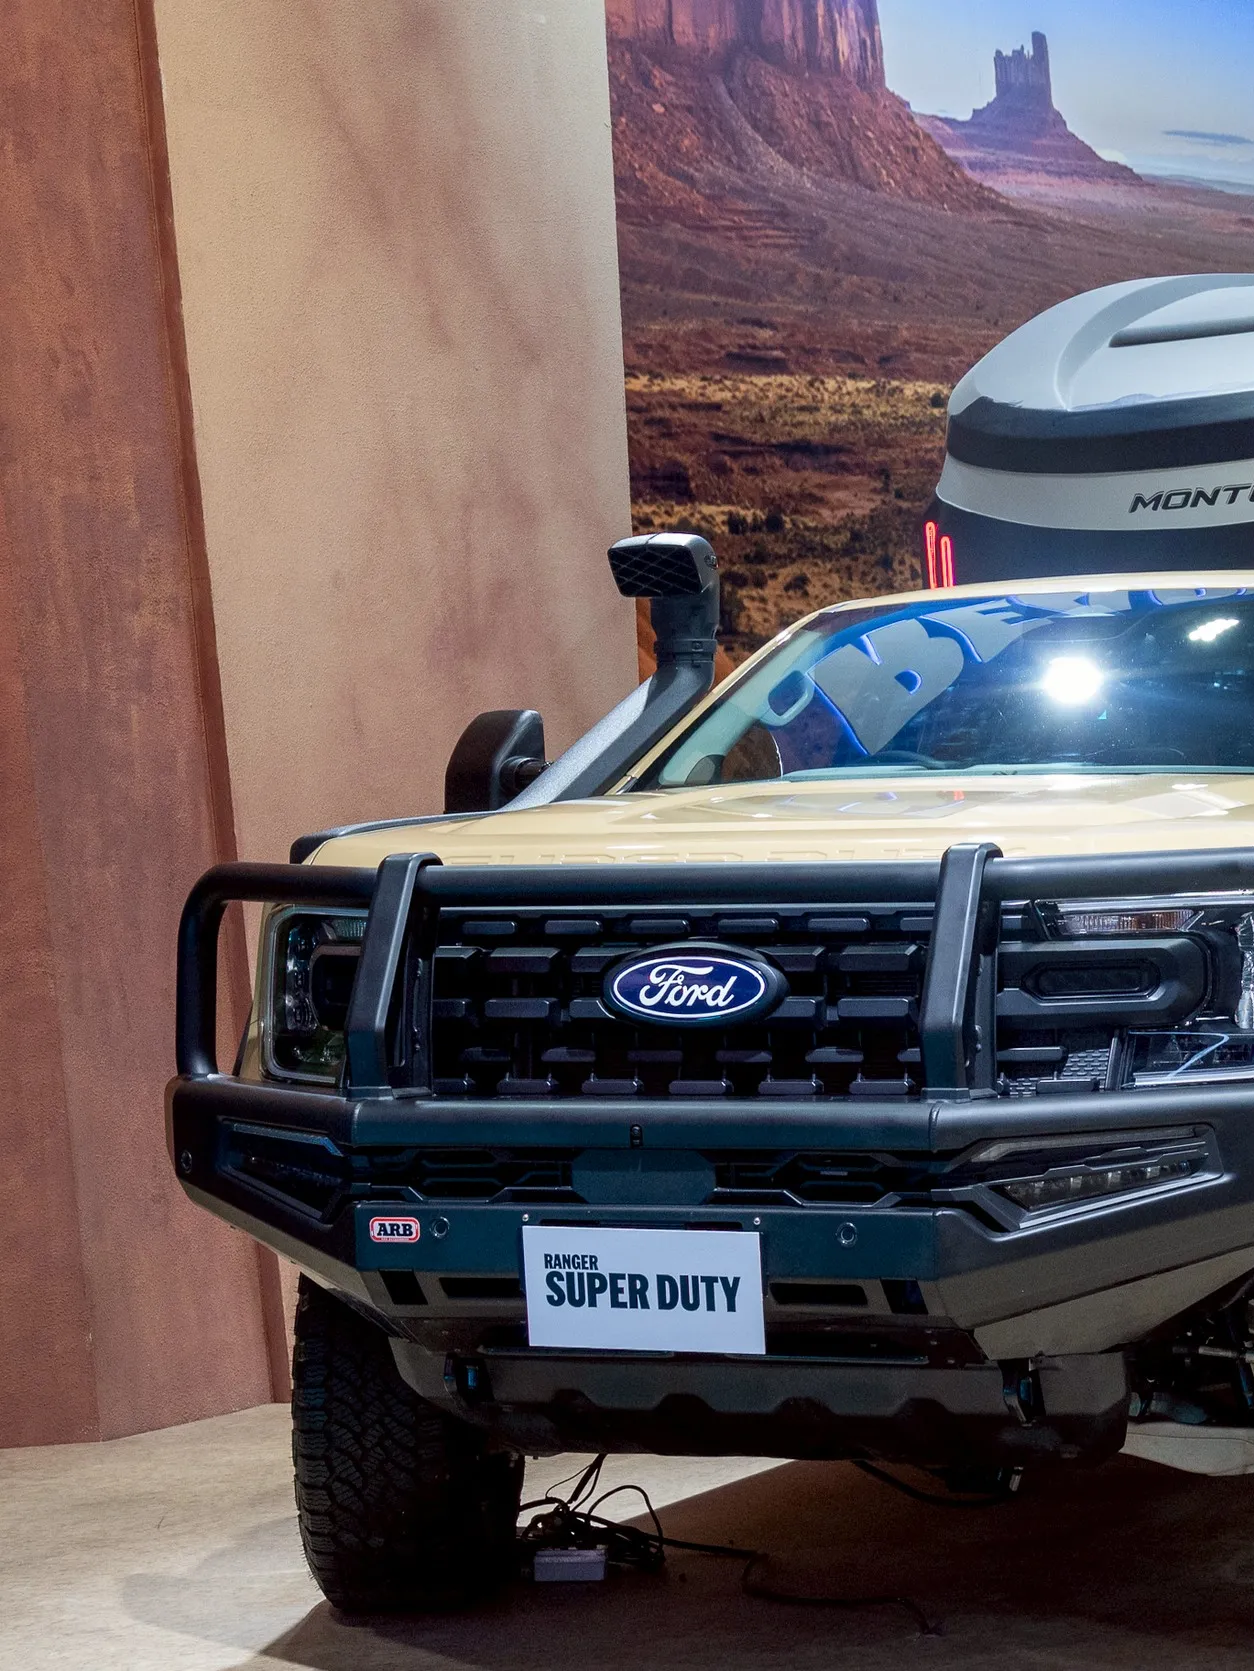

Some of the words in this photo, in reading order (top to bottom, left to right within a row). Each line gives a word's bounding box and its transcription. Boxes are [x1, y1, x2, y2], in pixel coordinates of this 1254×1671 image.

[639, 964, 737, 1007] Ford
[376, 1222, 414, 1237] ARB
[543, 1253, 598, 1271] RANGER
[545, 1270, 650, 1310] SUPER
[656, 1273, 741, 1313] DUTY
